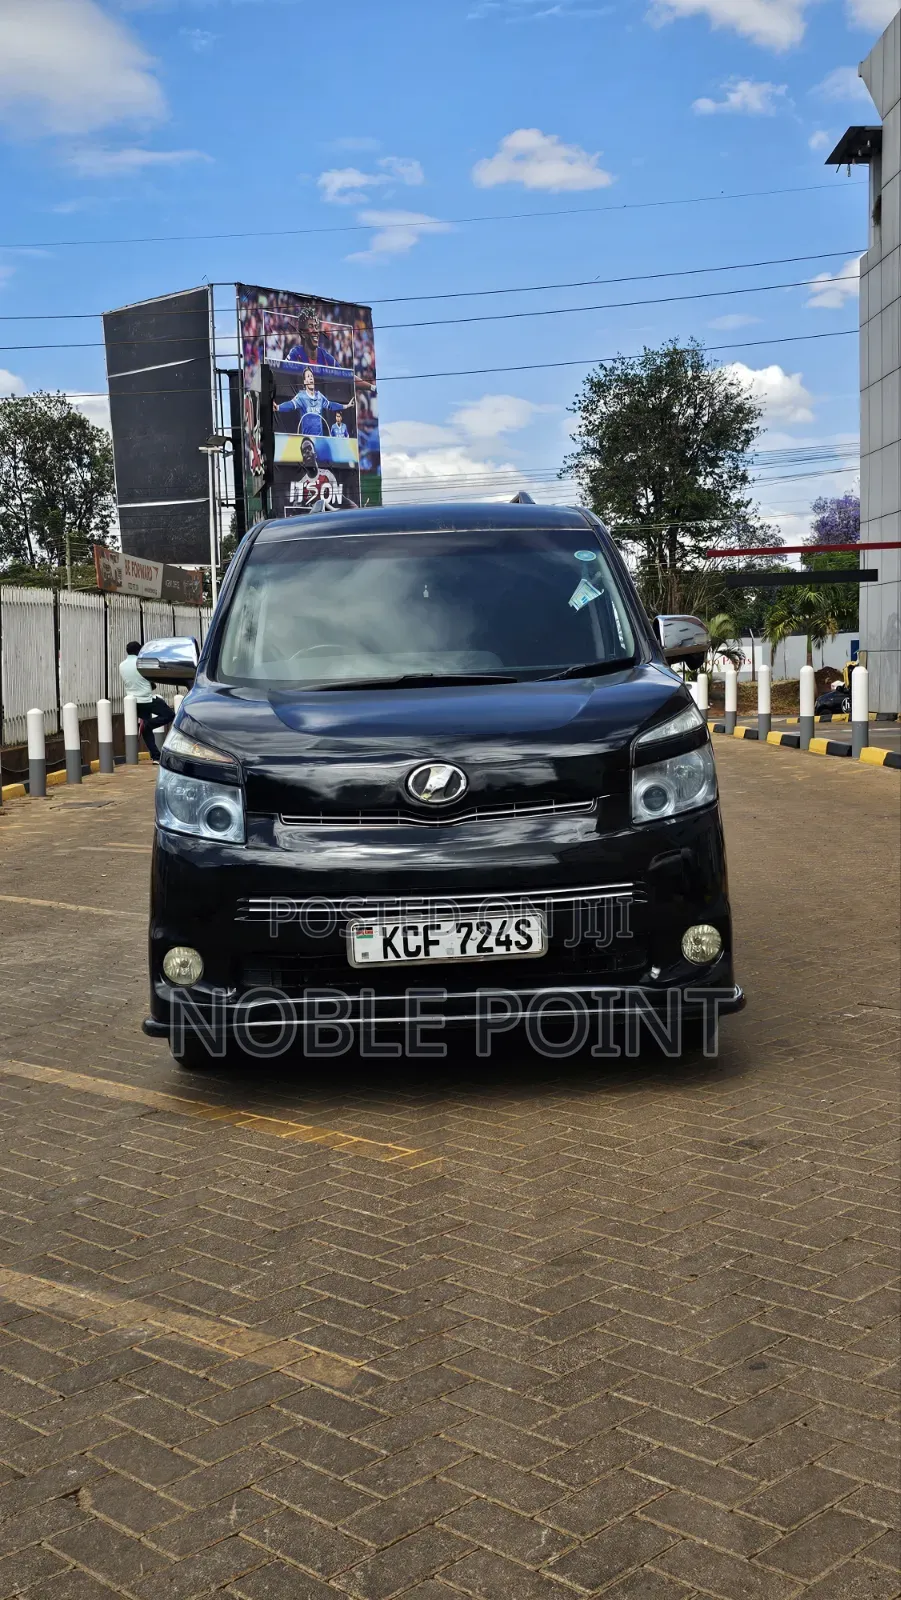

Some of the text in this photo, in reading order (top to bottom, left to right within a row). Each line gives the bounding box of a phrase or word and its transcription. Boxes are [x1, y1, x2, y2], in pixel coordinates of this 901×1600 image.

[320, 482, 343, 505] ON
[124, 559, 153, 582] BE FORWARD
[382, 918, 533, 960] KCF 724S
